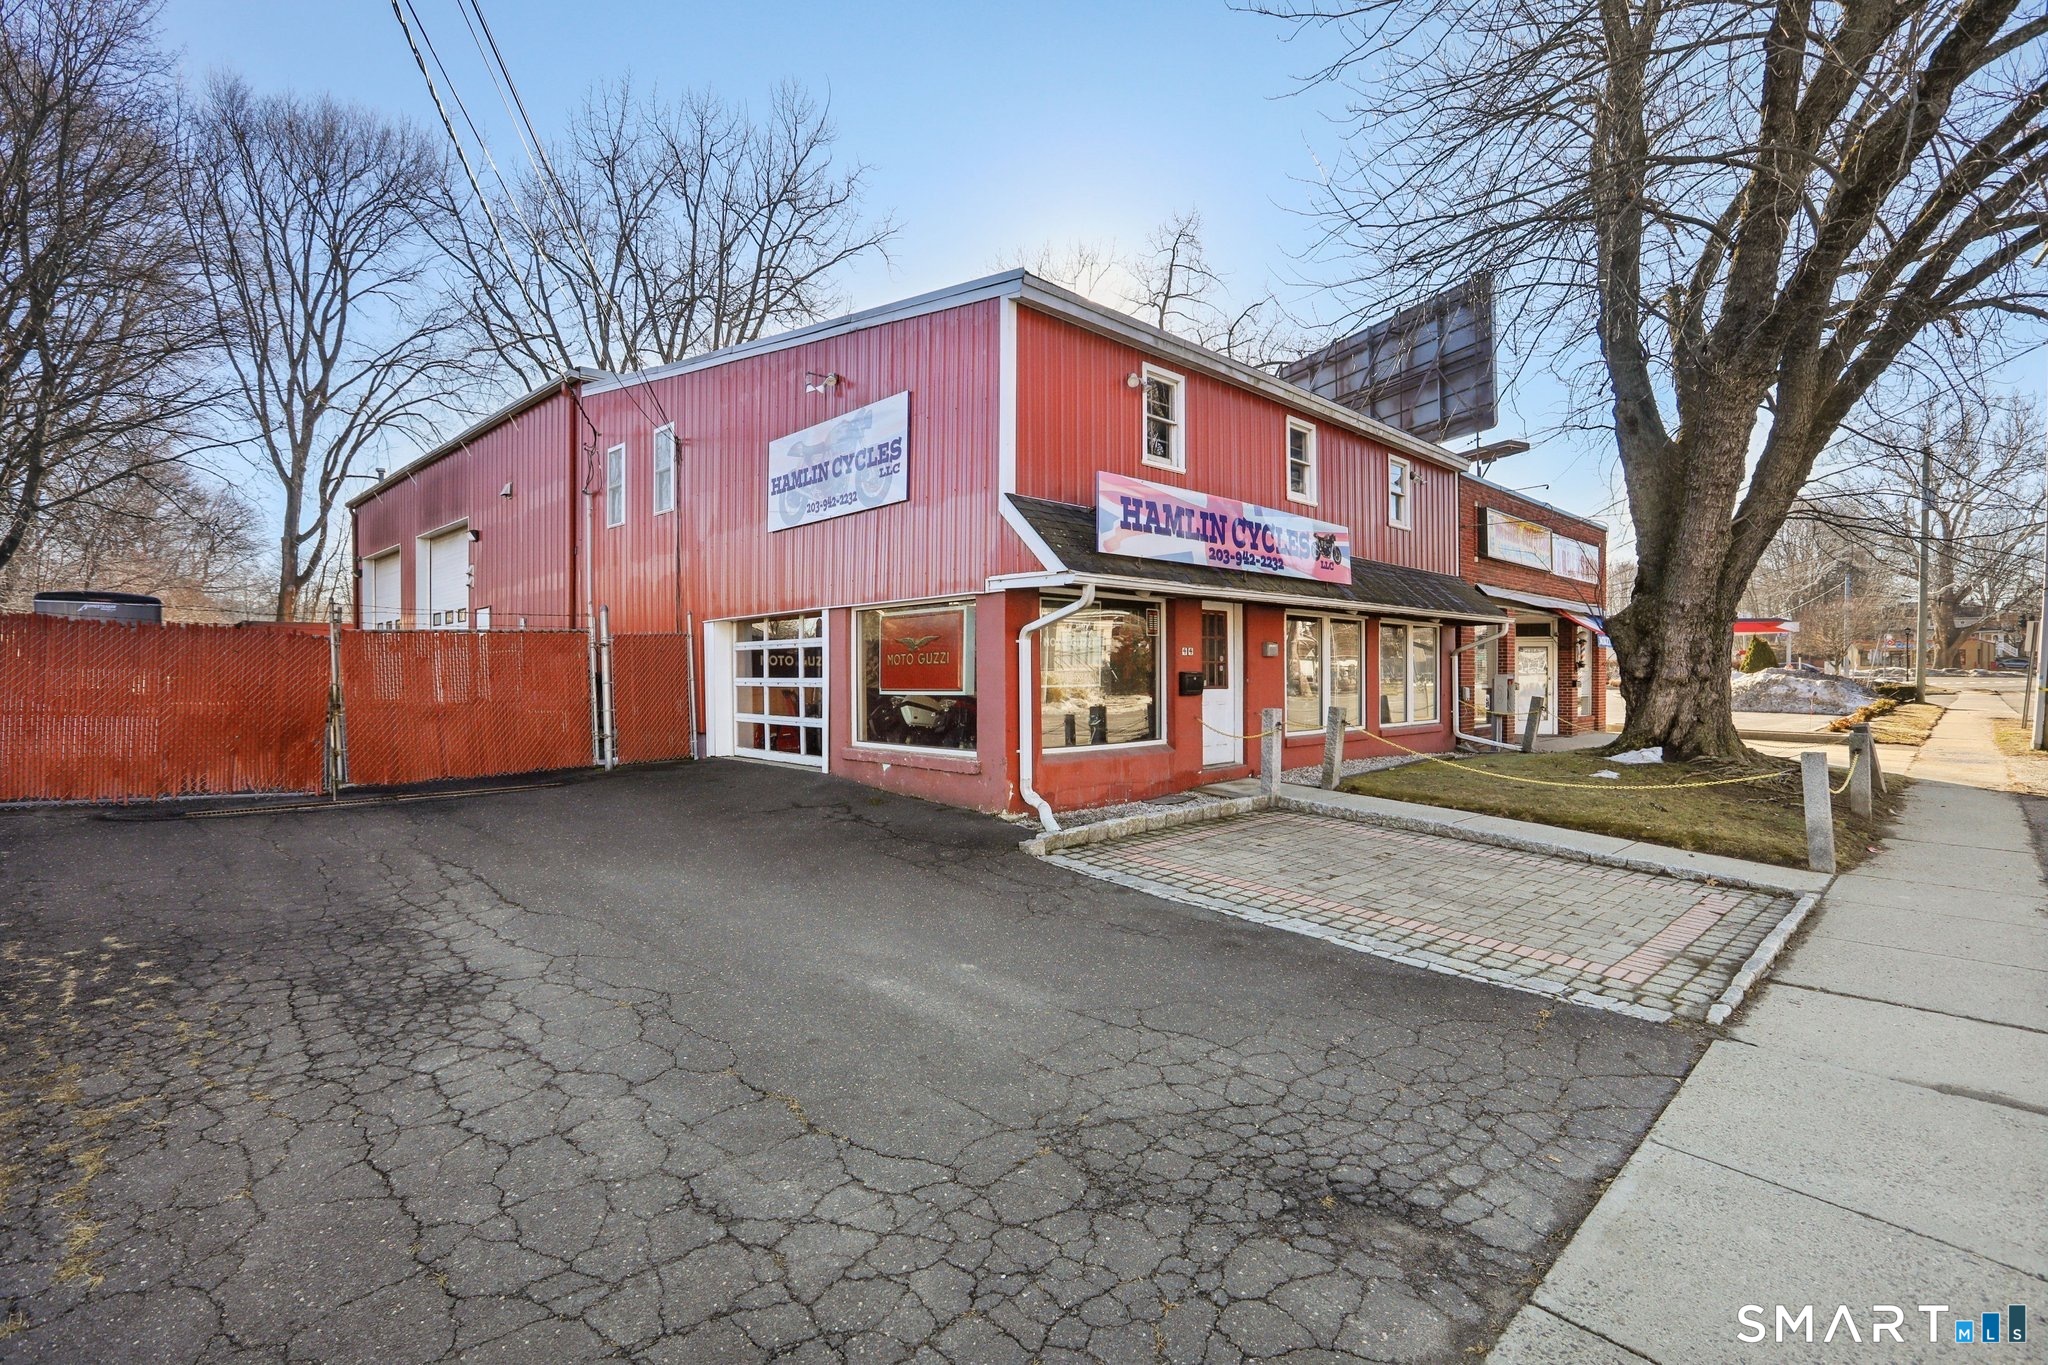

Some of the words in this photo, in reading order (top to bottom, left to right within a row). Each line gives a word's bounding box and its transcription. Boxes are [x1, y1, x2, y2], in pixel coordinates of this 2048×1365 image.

[771, 461, 830, 496] HAMLIN
[832, 436, 903, 478] CYCLES
[880, 463, 900, 478] LLC
[806, 491, 858, 514] 203-942-2232
[1119, 496, 1228, 546] HAMLIN
[1231, 517, 1311, 559] CYCLES
[1208, 547, 1285, 570] 203-942-2232
[1320, 560, 1335, 571] LLC
[760, 655, 794, 667] OTO
[887, 653, 914, 666] MOTO
[917, 651, 950, 665] GUZZI
